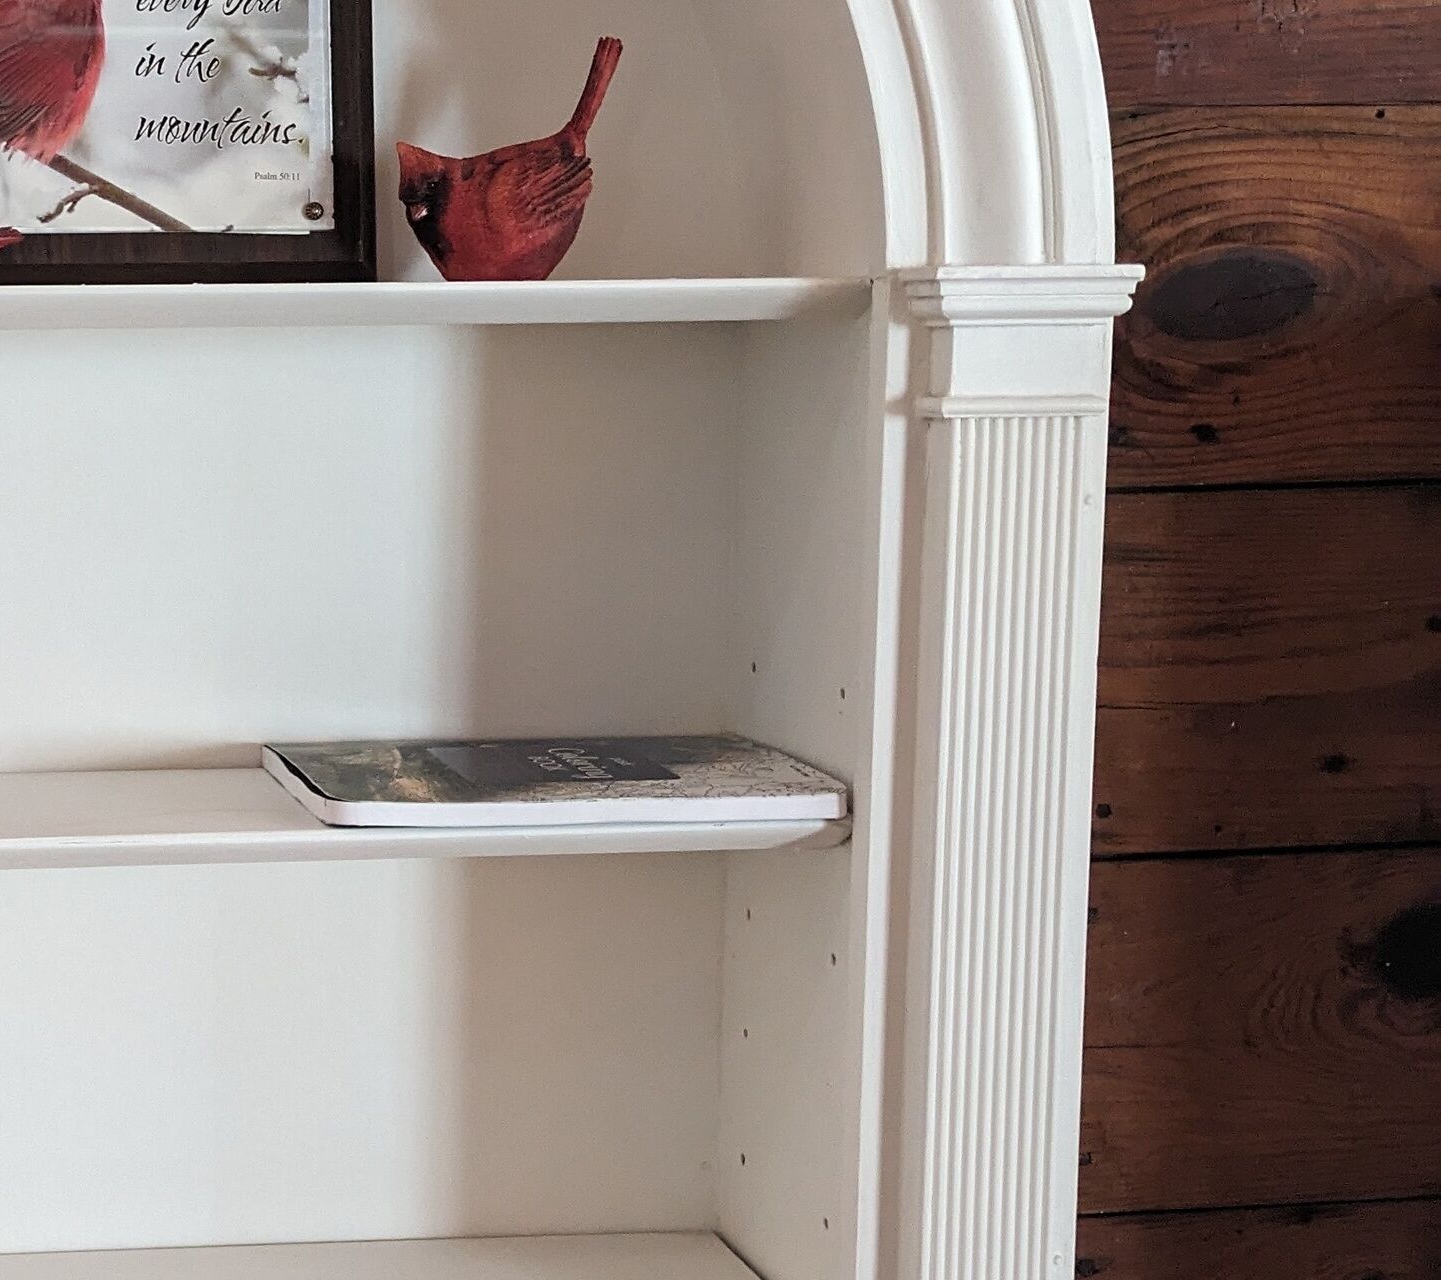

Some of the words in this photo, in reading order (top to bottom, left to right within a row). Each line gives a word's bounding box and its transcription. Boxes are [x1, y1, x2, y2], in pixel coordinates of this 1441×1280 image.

[135, 42, 166, 77] in
[174, 38, 220, 83] the
[134, 107, 303, 149] mountains.
[254, 172, 278, 181] Psalm
[279, 172, 300, 181] 50:11
